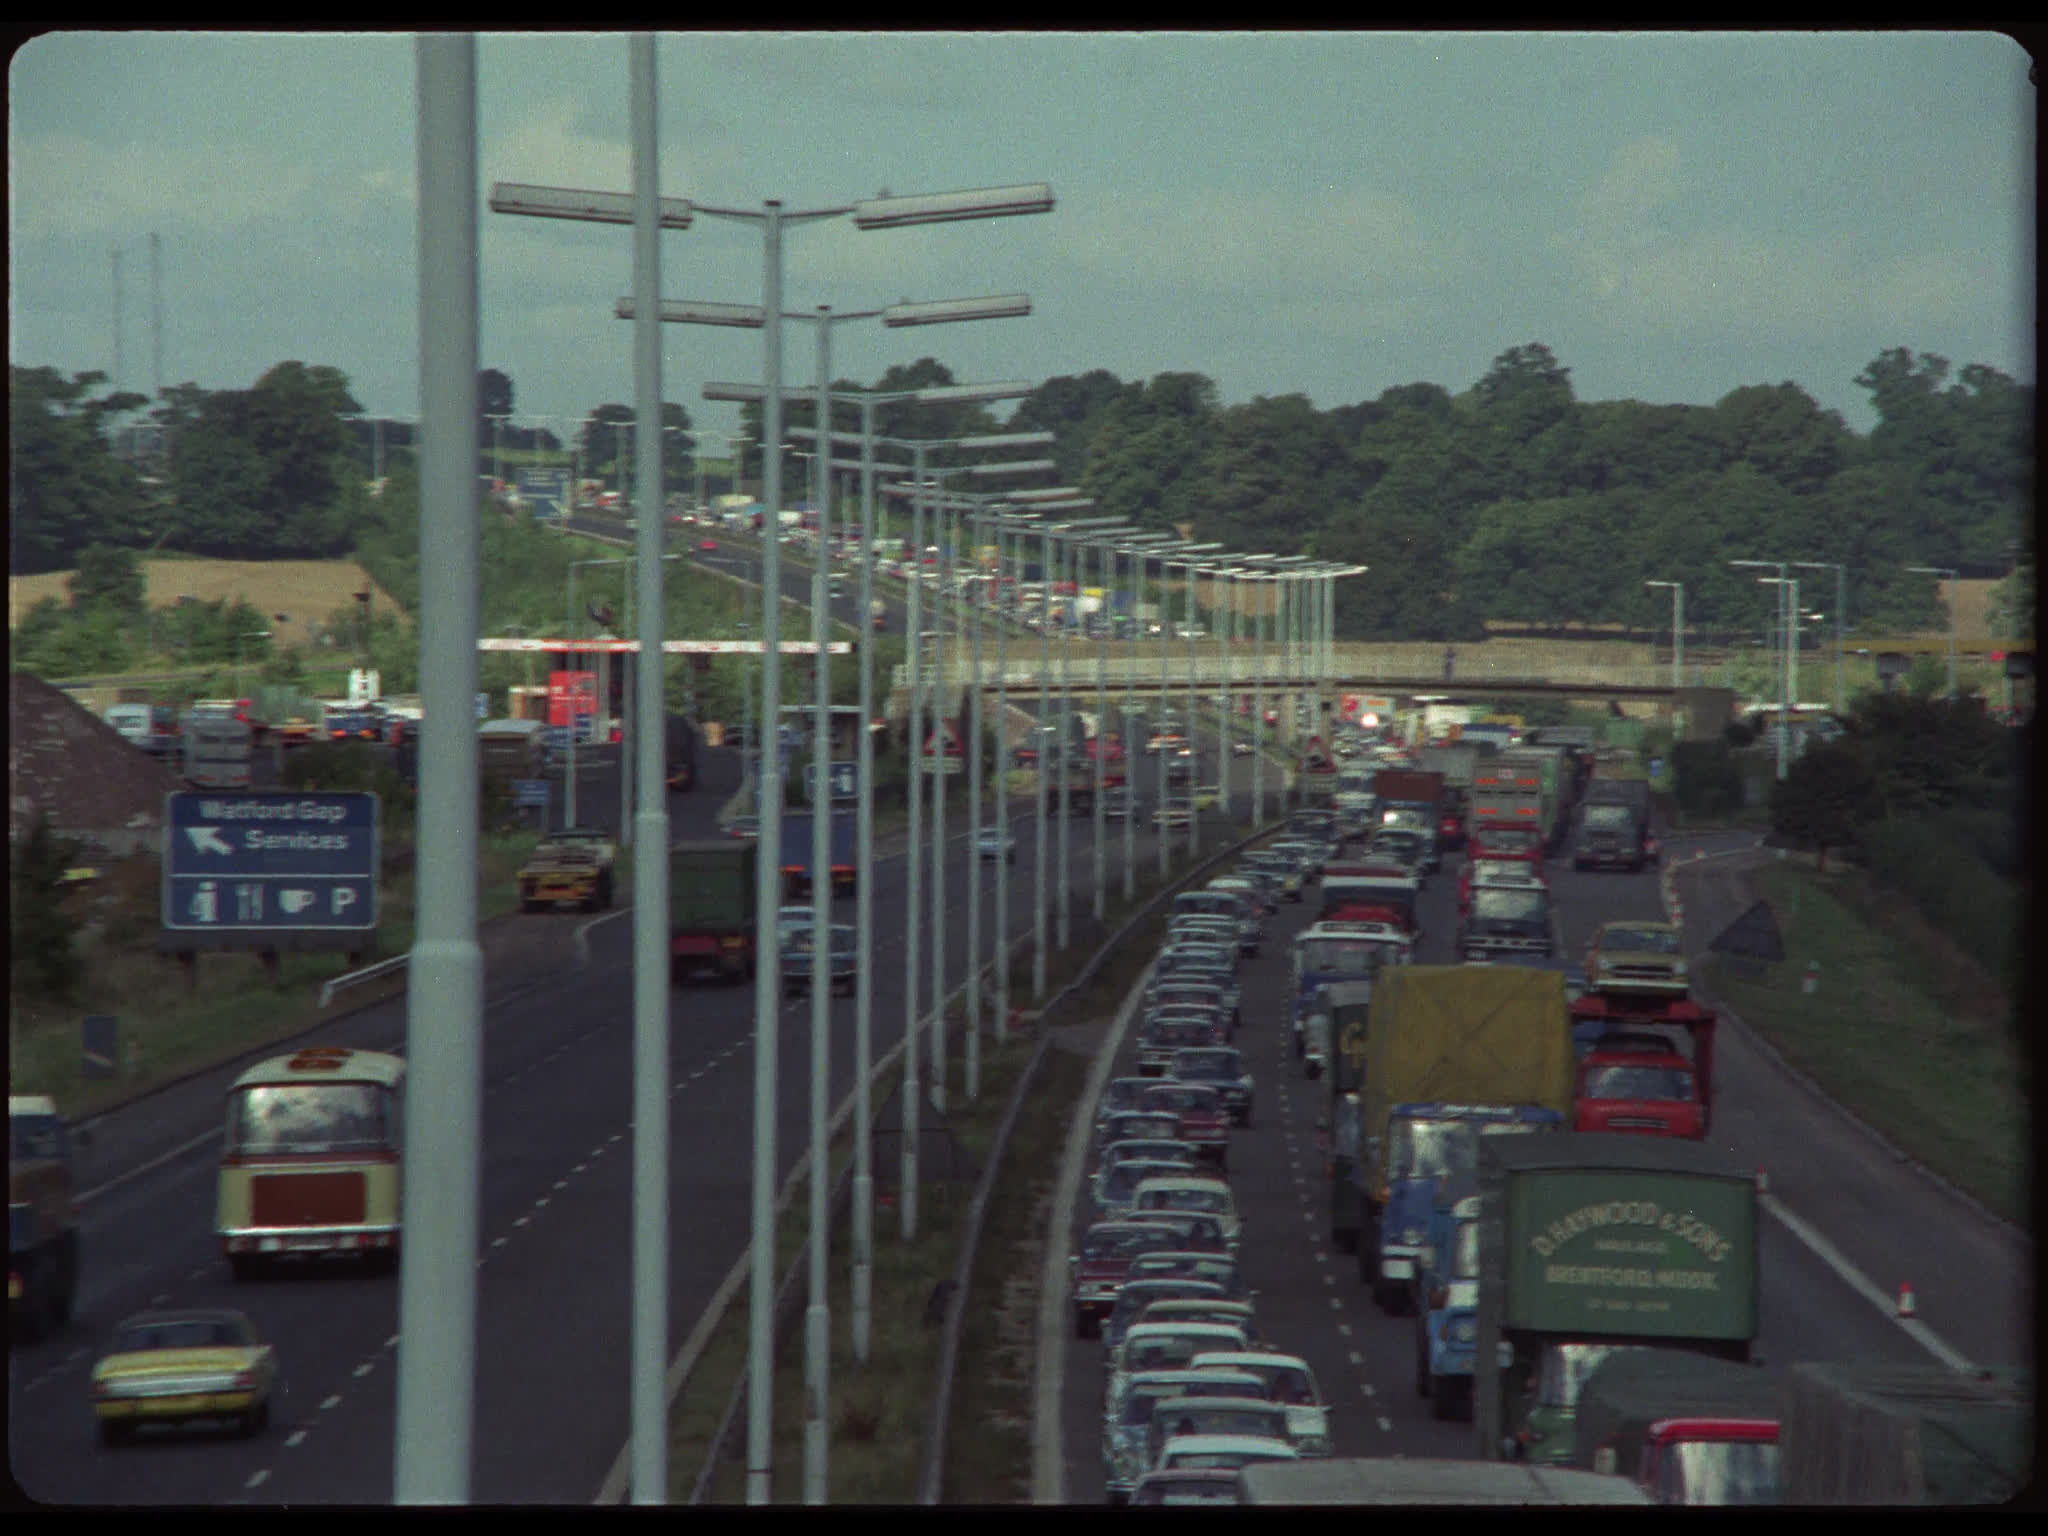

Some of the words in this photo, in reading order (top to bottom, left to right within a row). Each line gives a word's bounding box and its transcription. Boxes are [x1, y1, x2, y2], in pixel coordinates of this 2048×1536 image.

[199, 800, 296, 820] Watford
[298, 800, 347, 824] Gap
[244, 829, 349, 850] Services
[330, 886, 357, 916] P
